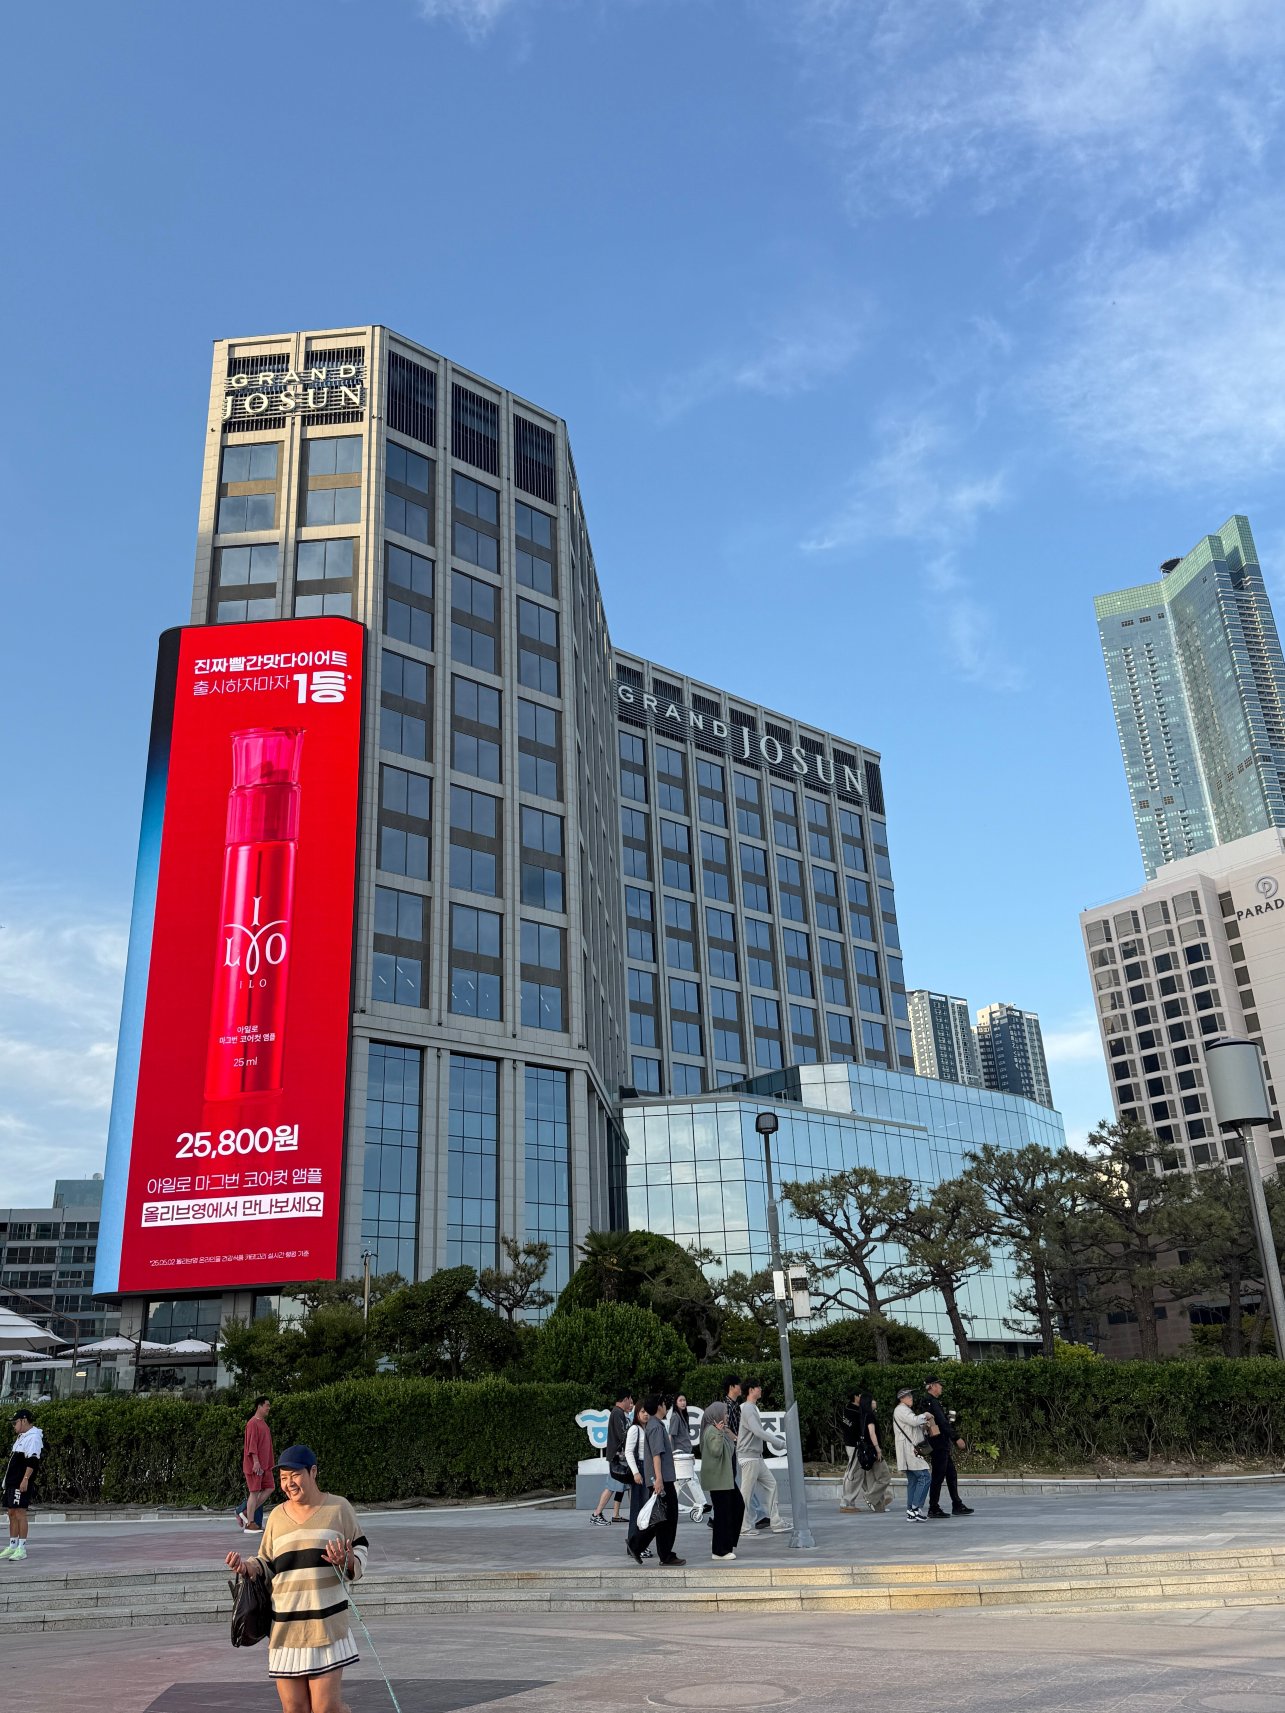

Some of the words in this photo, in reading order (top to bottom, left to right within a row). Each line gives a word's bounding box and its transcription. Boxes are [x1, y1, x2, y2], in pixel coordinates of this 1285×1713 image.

[231, 365, 356, 388] GRAND
[222, 384, 362, 423] JOSUN
[193, 675, 290, 696] 출시하자마자
[617, 685, 728, 738] GRAND
[740, 726, 863, 796] JOSUN
[1236, 898, 1285, 921] PARAD
[219, 1036, 238, 1044] 마그번
[240, 1034, 262, 1043] 코어컷
[237, 1025, 259, 1034] 아일로
[233, 1057, 245, 1067] 25
[246, 1056, 258, 1066] ml
[175, 1124, 299, 1159] 25,800원
[147, 1177, 191, 1194] 아일로
[195, 1173, 240, 1191] 마그번
[243, 1169, 288, 1188] 코어컷
[292, 1167, 323, 1184] 앰플
[144, 1201, 238, 1223] 올리브영에서
[242, 1196, 322, 1216] 만나보세요
[13, 1488, 21, 1505] UFC
